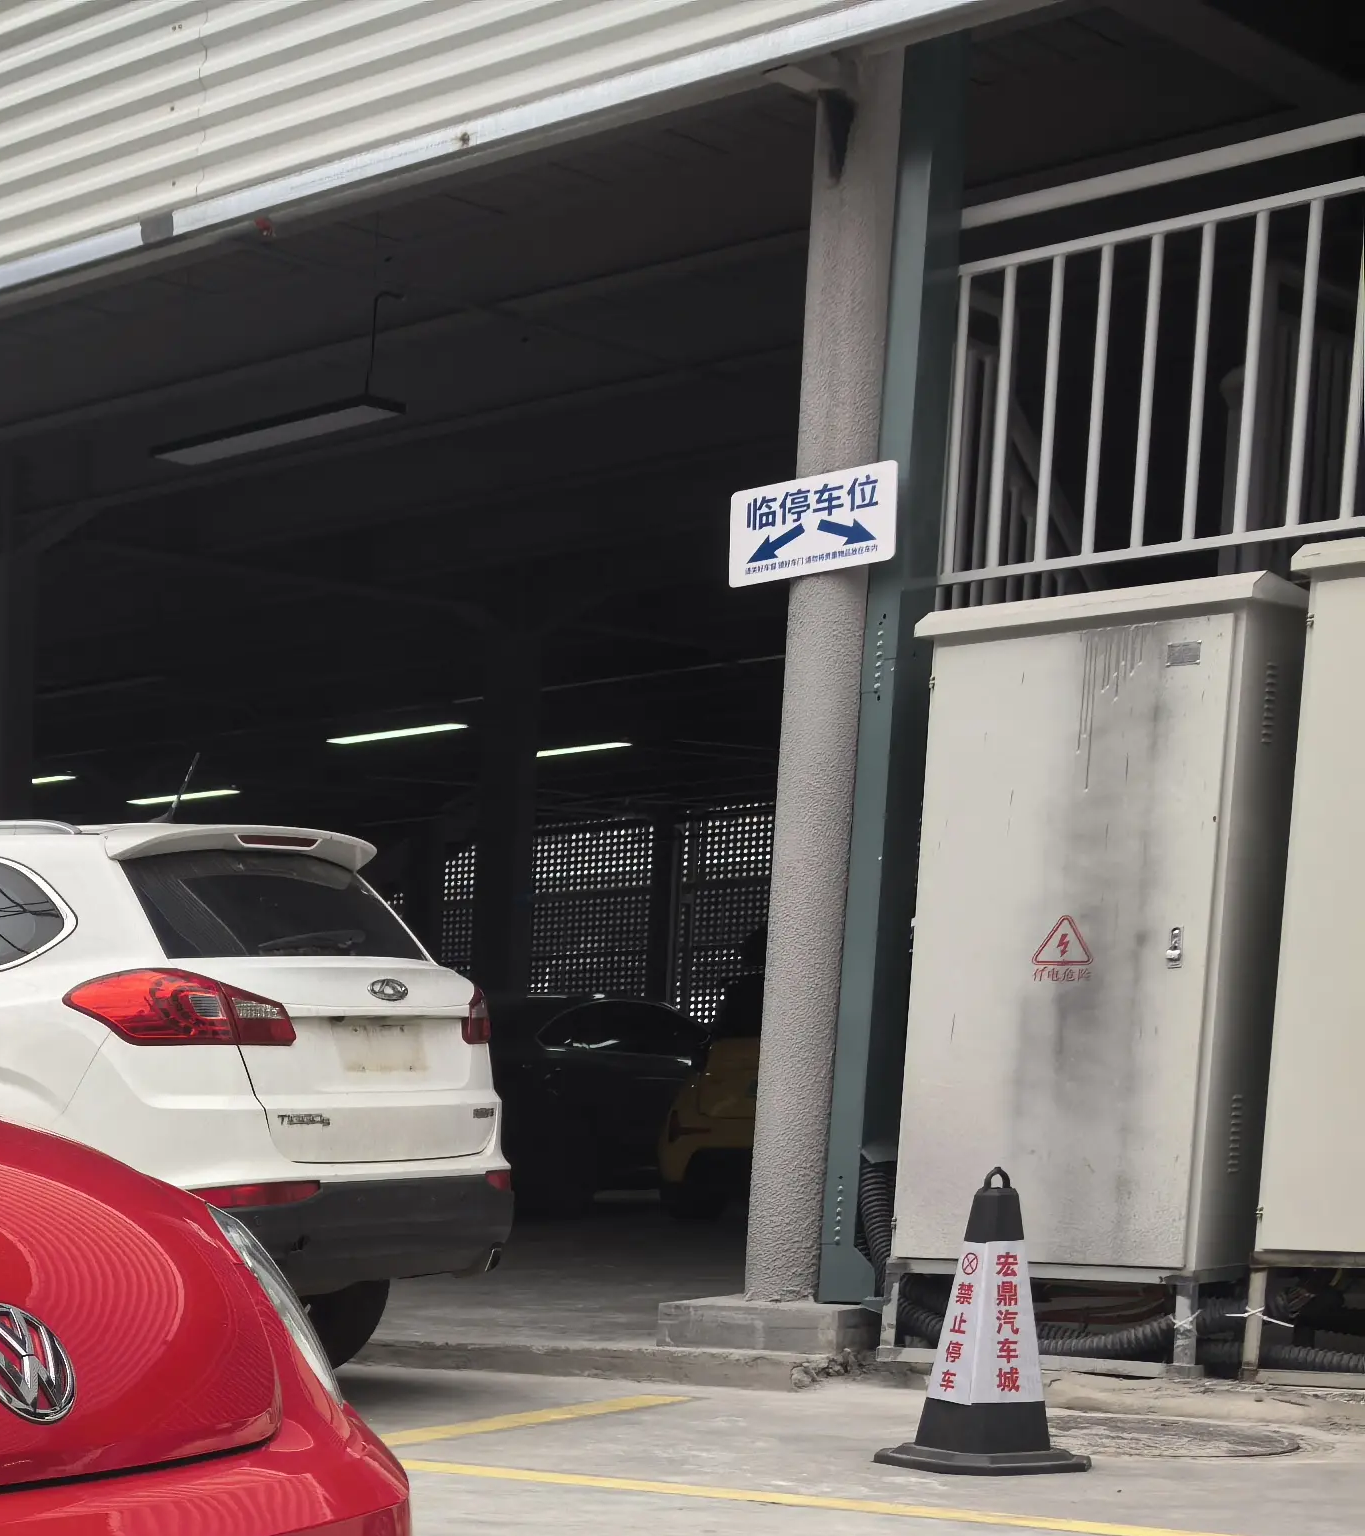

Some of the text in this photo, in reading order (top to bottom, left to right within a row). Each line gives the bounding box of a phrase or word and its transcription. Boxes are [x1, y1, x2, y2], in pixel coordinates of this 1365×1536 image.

[746, 474, 879, 530] 临停车位
[939, 1281, 974, 1392] 禁止停车
[995, 1251, 1020, 1392] 宏鼎汽车城
